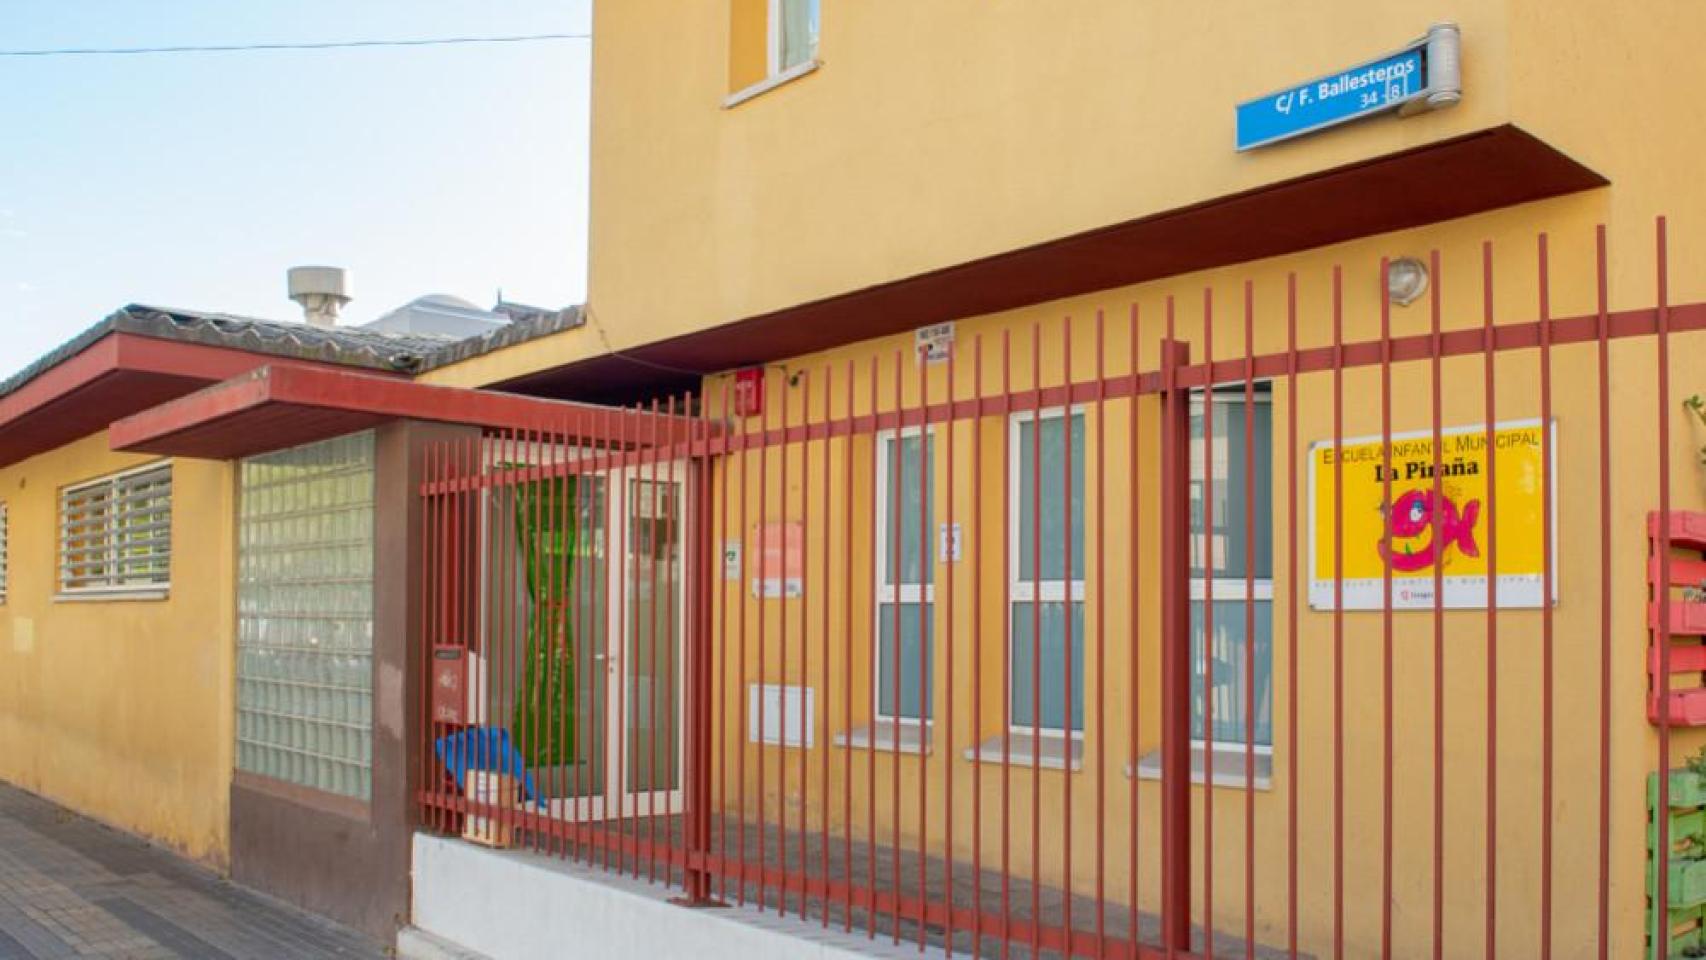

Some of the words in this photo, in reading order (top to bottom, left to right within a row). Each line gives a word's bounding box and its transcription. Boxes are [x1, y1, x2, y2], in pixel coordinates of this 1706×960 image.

[1275, 91, 1295, 115] C/
[1299, 88, 1313, 106] F.
[1317, 58, 1415, 100] Ballesteros
[1323, 444, 1390, 465] ECUELA
[1455, 431, 1539, 453] MUNCIPAL
[1406, 457, 1479, 480] Piraña
